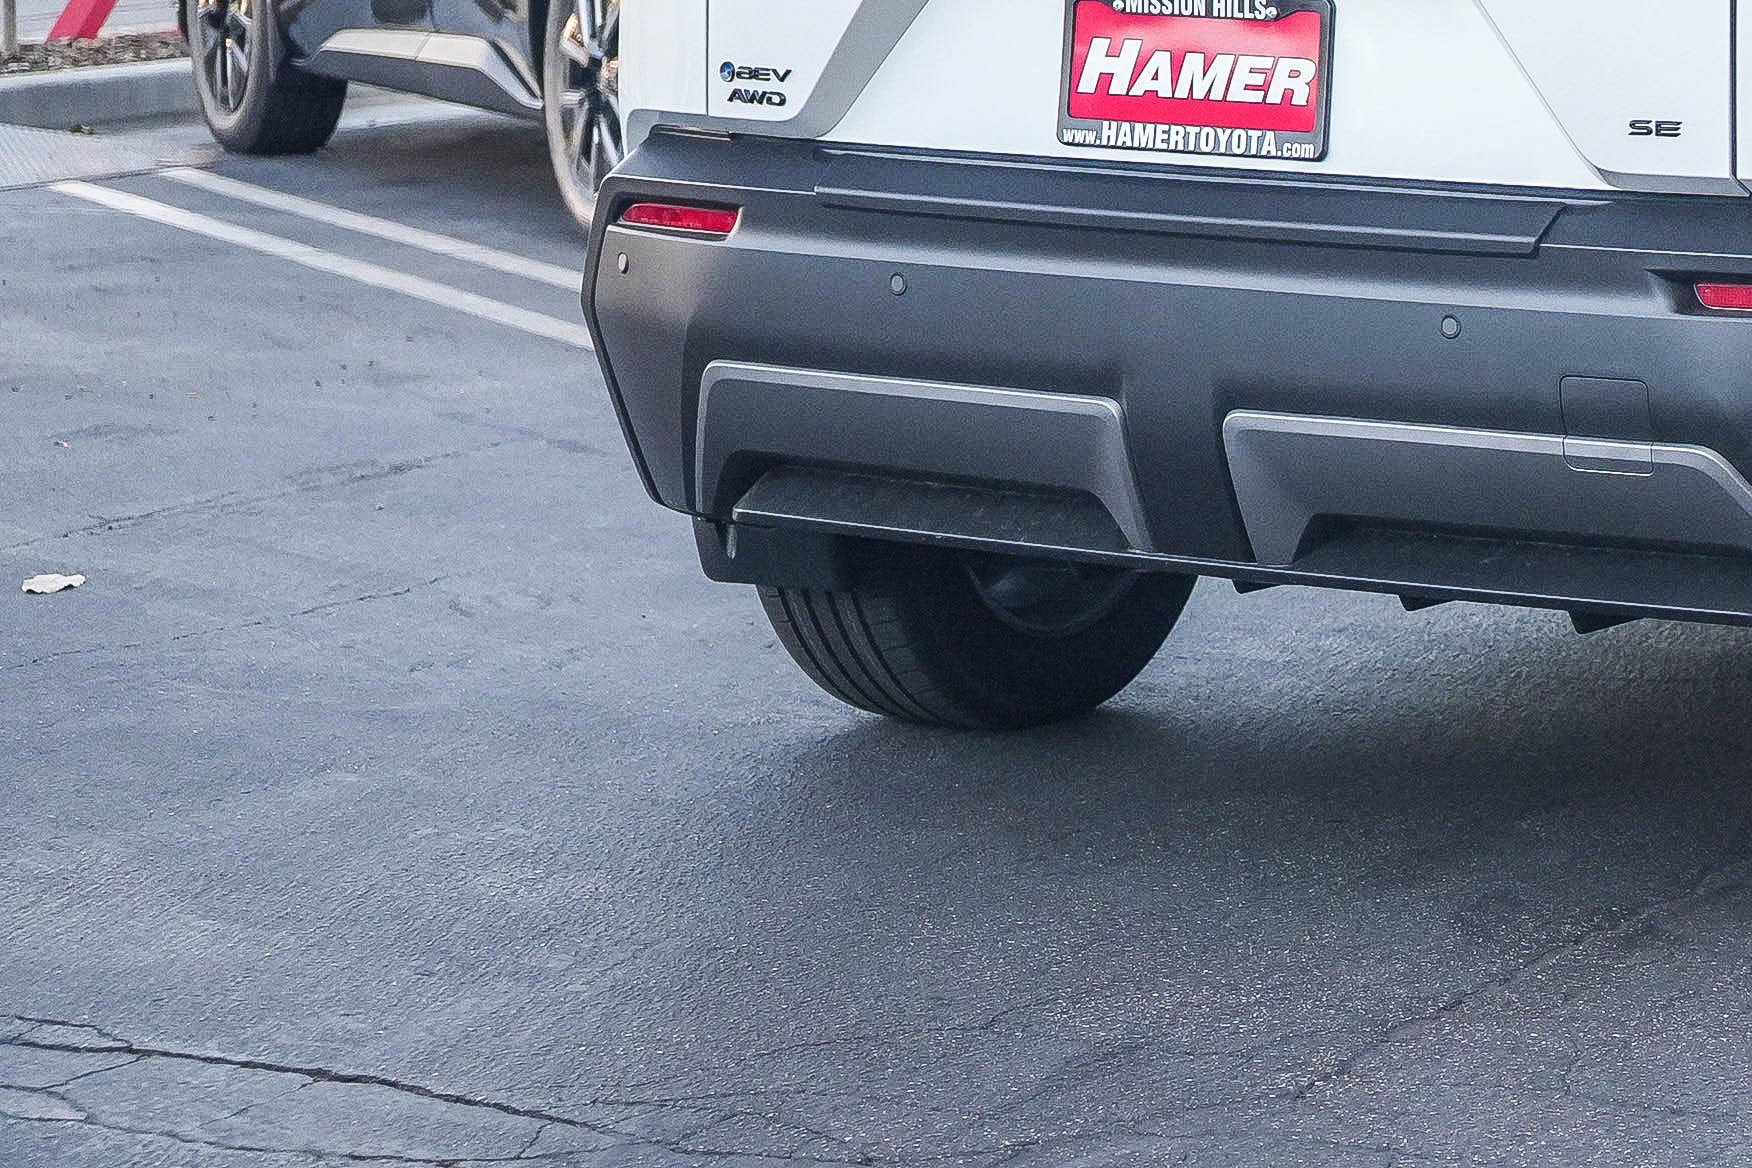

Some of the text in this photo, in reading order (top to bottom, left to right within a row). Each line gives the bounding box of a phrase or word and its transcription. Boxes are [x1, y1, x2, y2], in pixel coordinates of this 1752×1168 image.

[735, 65, 793, 83] BEV
[1075, 36, 1318, 107] HAMER
[727, 88, 787, 107] AWD
[1627, 119, 1683, 138] SE
[1062, 120, 1316, 159] www.HAMERTOYOTA.com
